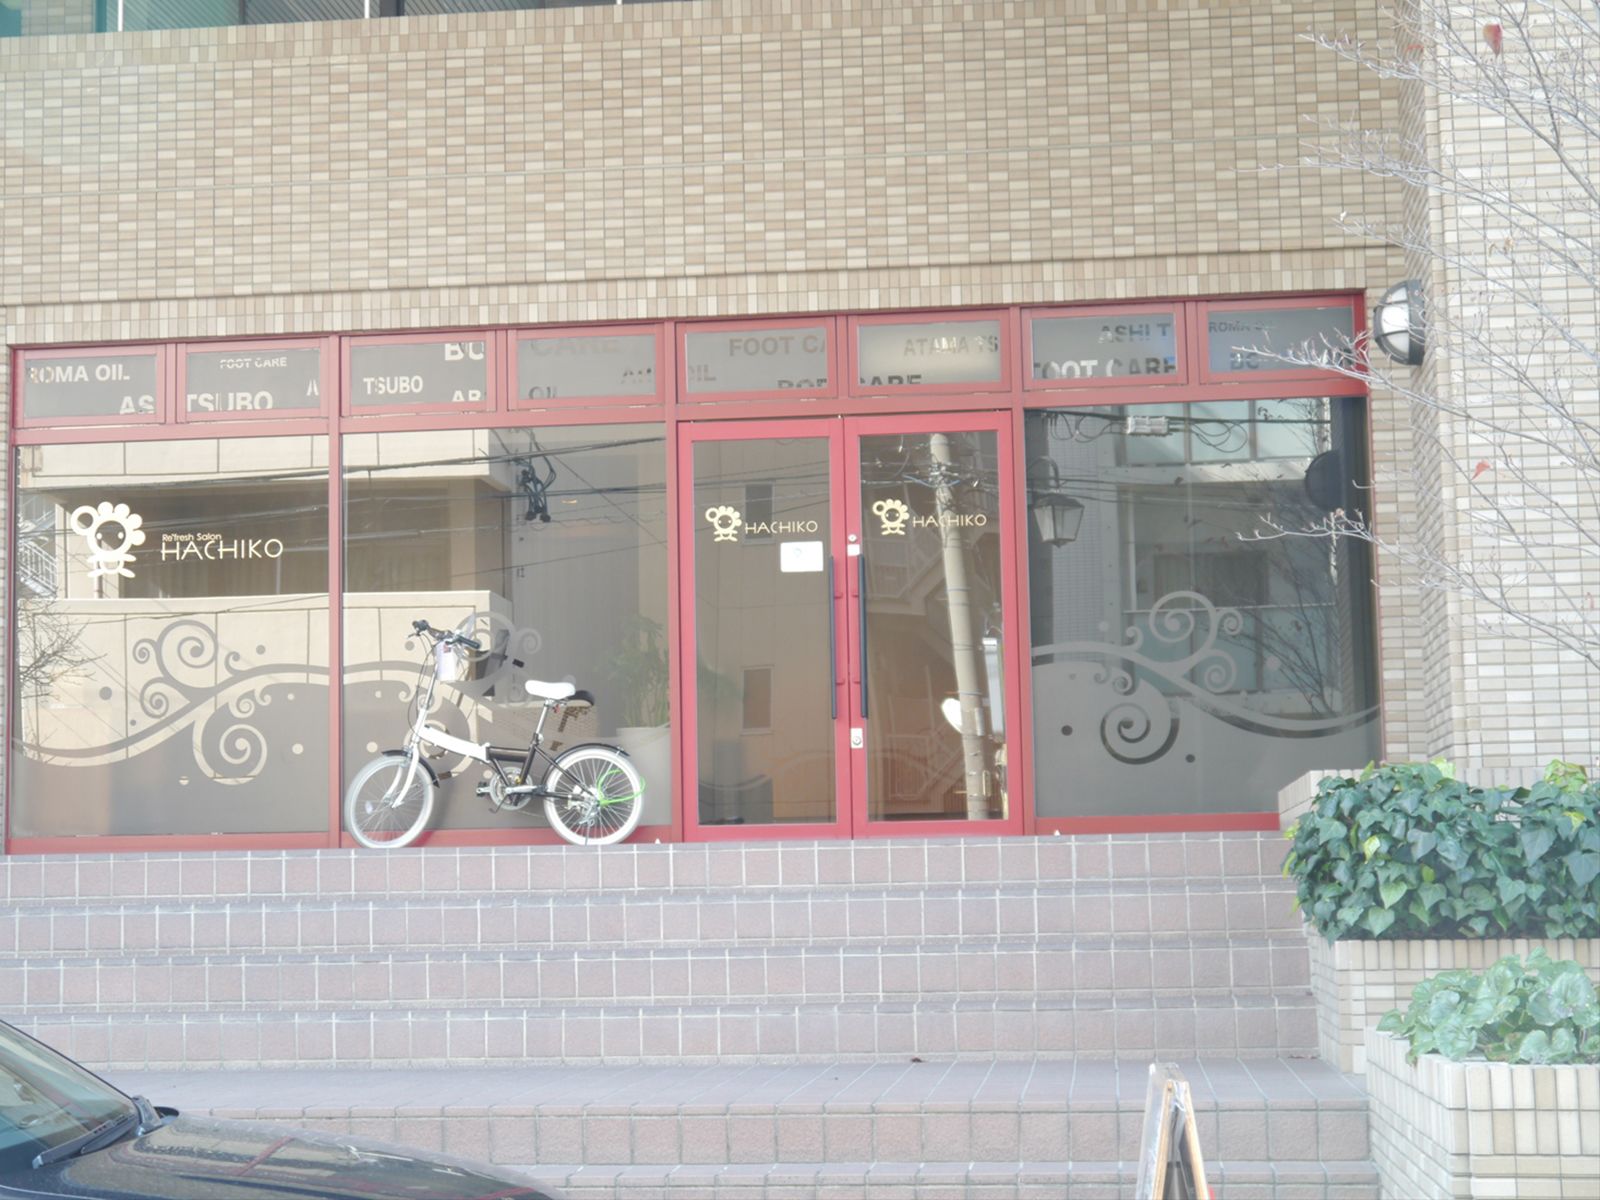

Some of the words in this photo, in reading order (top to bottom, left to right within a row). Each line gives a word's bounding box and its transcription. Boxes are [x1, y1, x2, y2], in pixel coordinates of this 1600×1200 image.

[1099, 323, 1150, 343] ASHI
[729, 336, 794, 357] FOOT
[95, 363, 130, 381] OIL
[220, 358, 252, 369] FOOT
[254, 356, 288, 368] CARE
[363, 375, 423, 395] TSUBO
[119, 394, 154, 414] AS
[187, 390, 273, 413] TSUBO
[745, 520, 818, 535] HACHIKO
[912, 513, 987, 528] HACHIKO
[196, 532, 222, 541] Salon
[161, 538, 283, 561] HACHIKO
